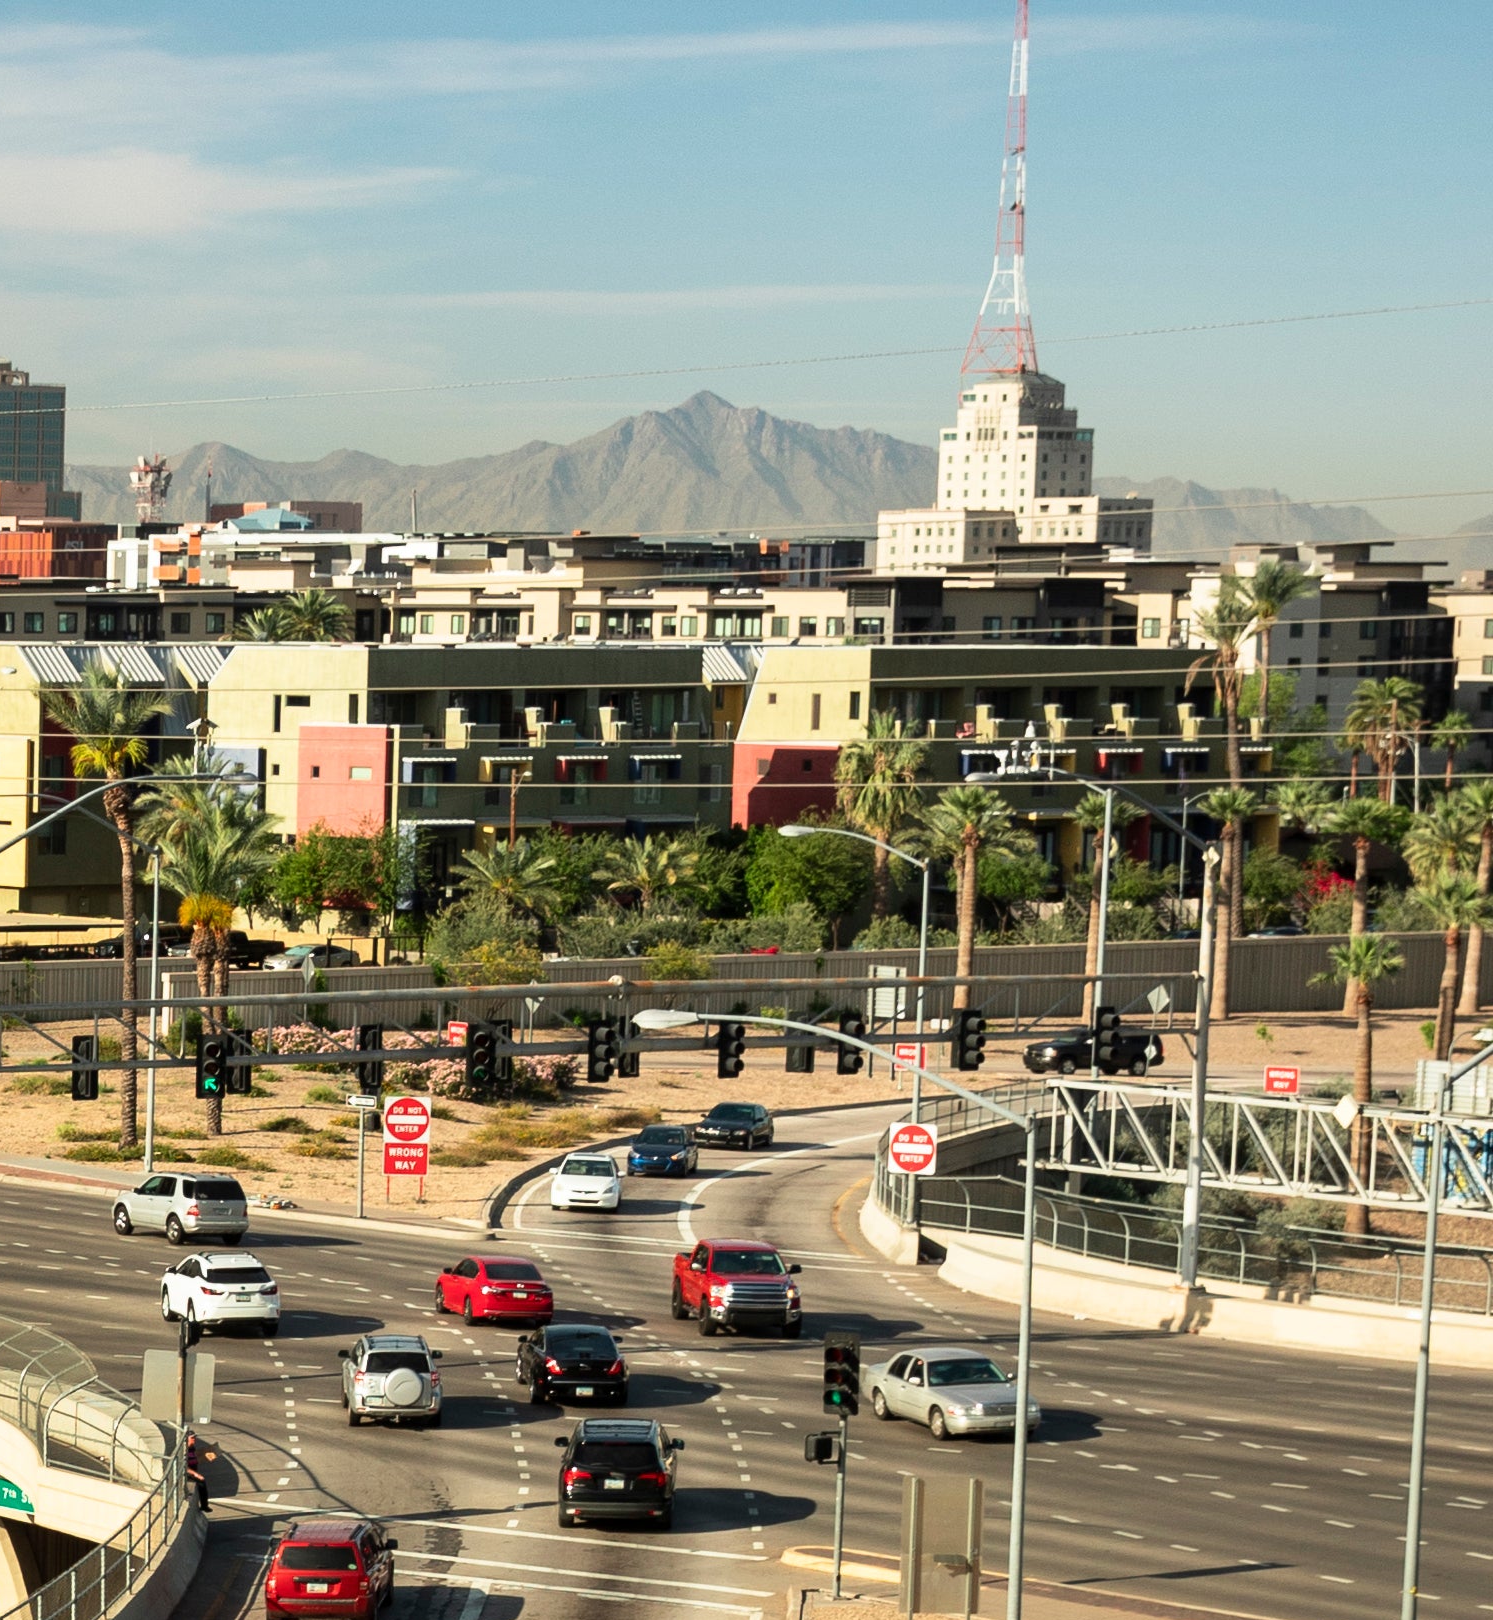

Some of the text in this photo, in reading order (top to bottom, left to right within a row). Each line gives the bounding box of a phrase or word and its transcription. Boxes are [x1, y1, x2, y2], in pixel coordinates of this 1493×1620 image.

[1268, 1071, 1295, 1080] WRONG
[1273, 1081, 1290, 1089] WAY
[393, 1106, 423, 1115] DO NOT
[394, 1125, 419, 1133] ENTER
[898, 1133, 928, 1143] DO NOT
[388, 1147, 424, 1158] WRONG
[899, 1154, 924, 1163] ENTER
[394, 1160, 417, 1170] WAY
[2, 1487, 17, 1499] 7th
